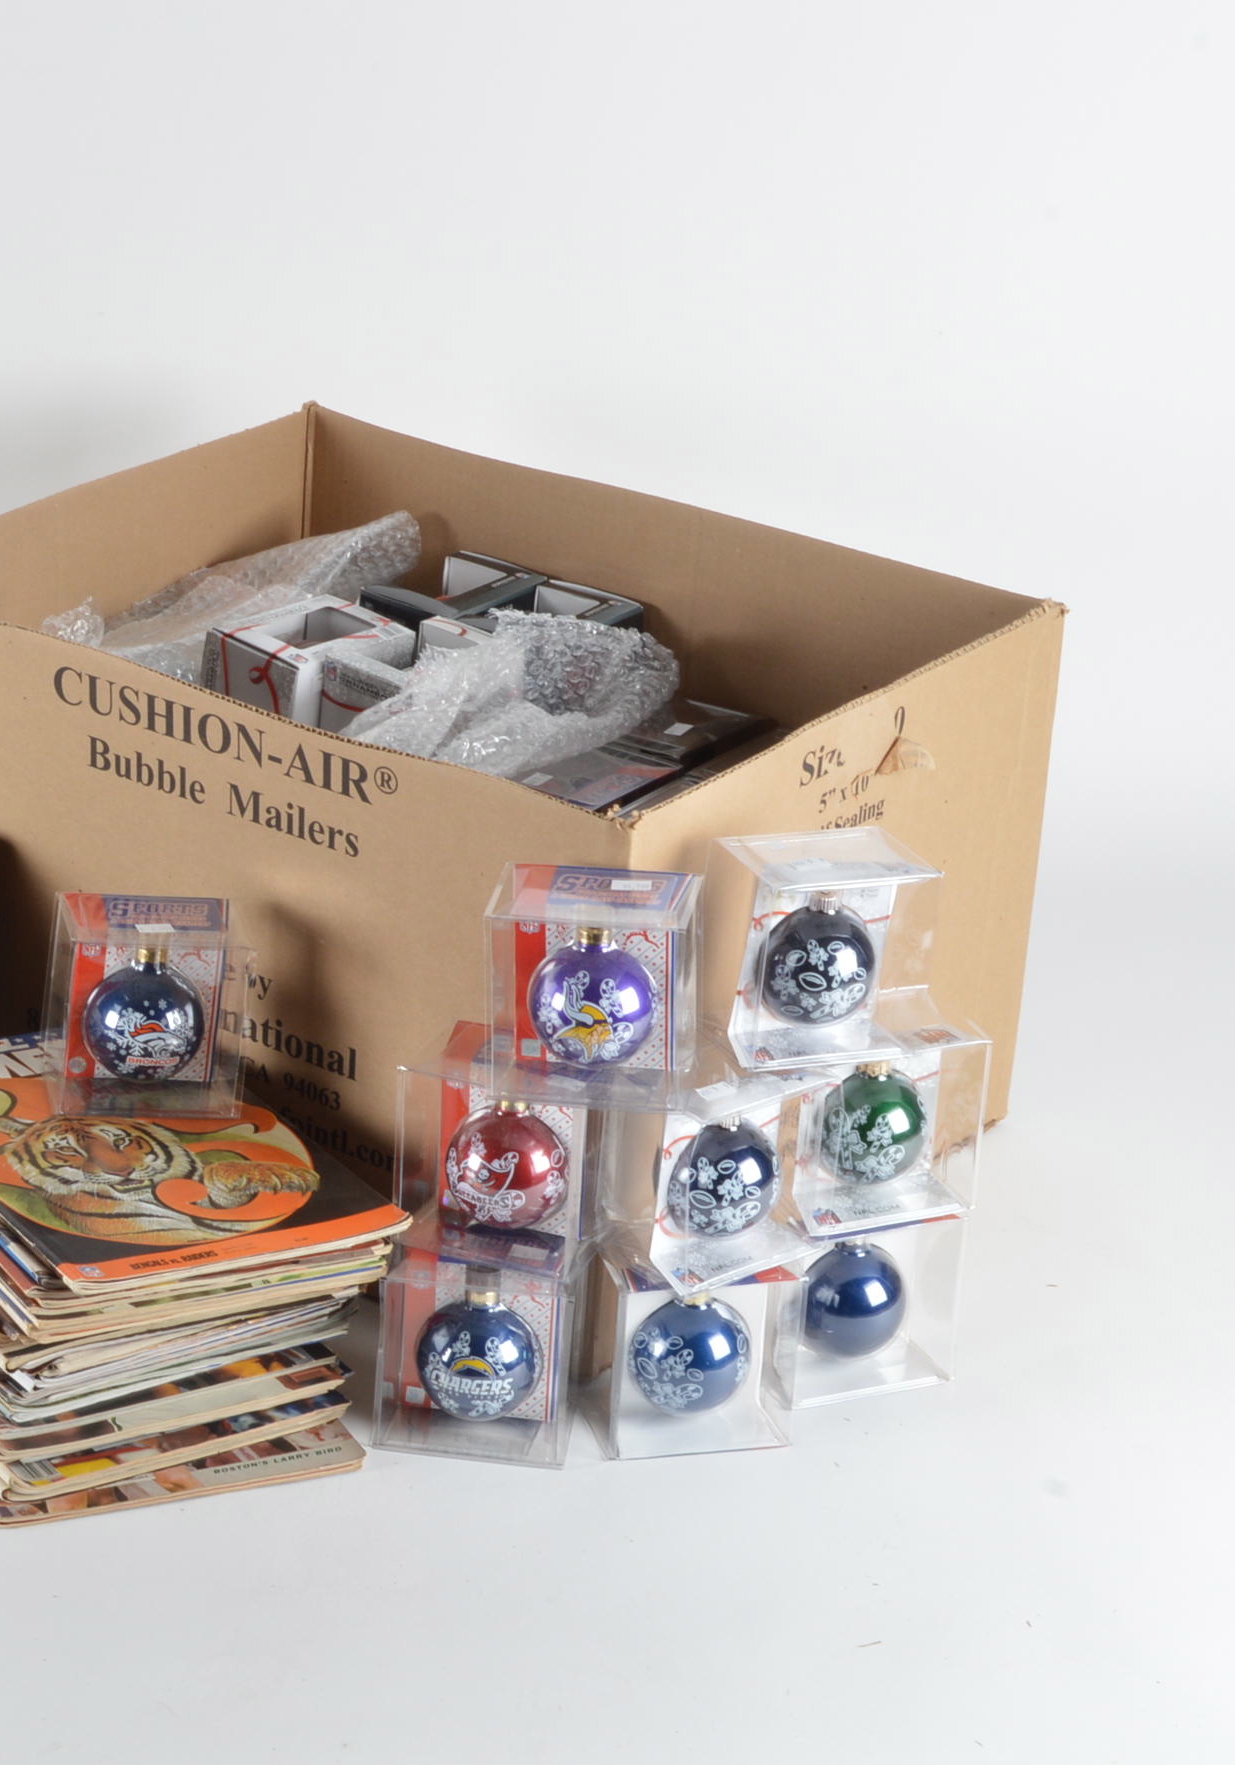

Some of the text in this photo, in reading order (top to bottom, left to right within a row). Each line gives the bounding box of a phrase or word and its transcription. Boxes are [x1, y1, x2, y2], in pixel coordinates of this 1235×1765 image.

[87, 734, 360, 858] Bubble Mailers
[834, 799, 885, 830] Sealing
[127, 1057, 179, 1066] BRONCOS
[284, 1072, 342, 1111] 94063
[130, 1258, 169, 1271] BENGALS
[431, 1369, 514, 1396] CHARGERS
[213, 1445, 342, 1475] BOSTON'S LARRY BIRD
